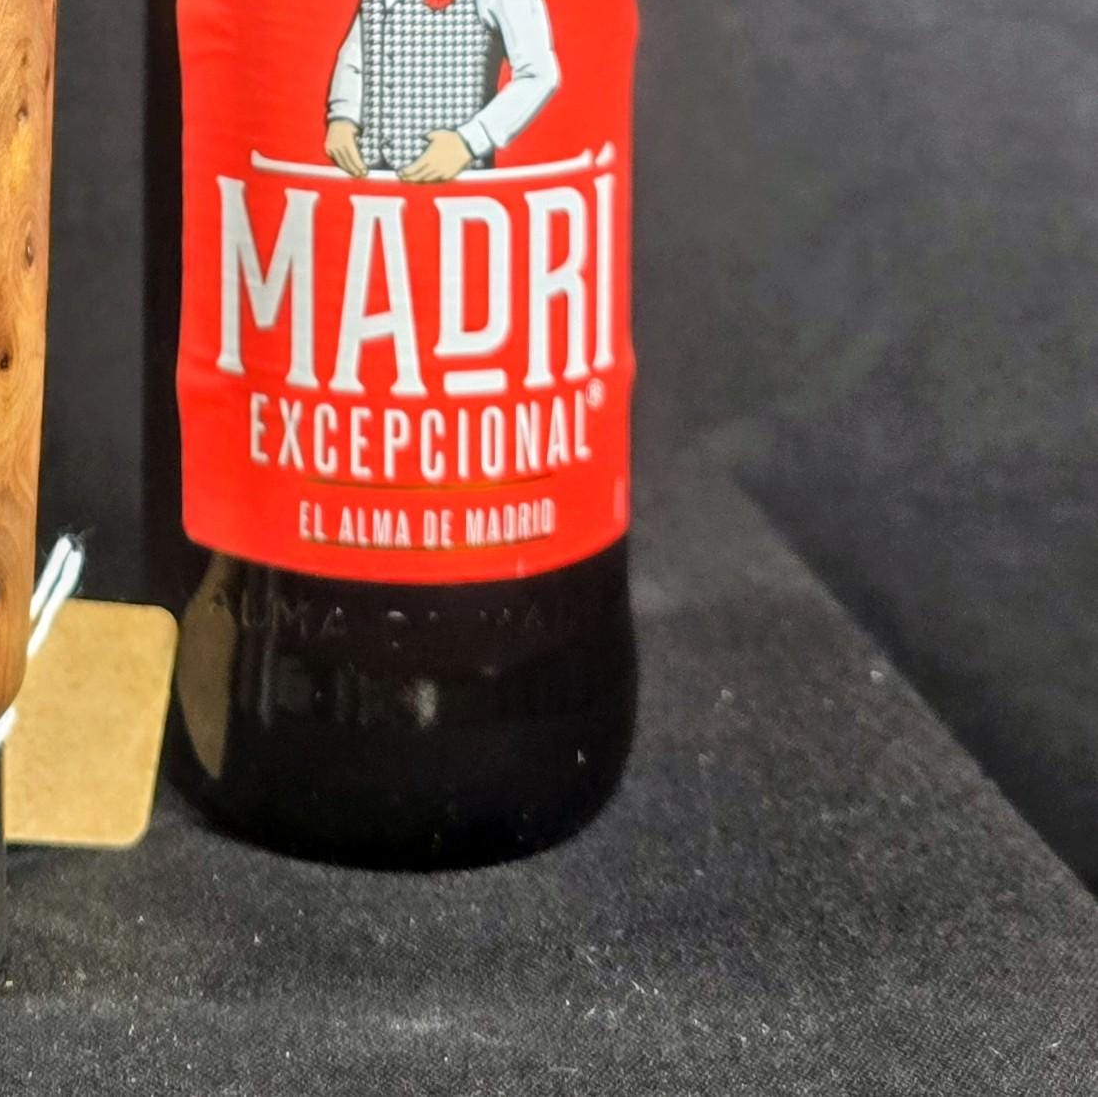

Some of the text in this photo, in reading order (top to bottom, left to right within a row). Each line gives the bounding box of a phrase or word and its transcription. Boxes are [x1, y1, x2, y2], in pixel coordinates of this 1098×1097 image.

[216, 142, 616, 397] MADRÍ
[299, 497, 555, 549] EL ALMA DE MADRID
